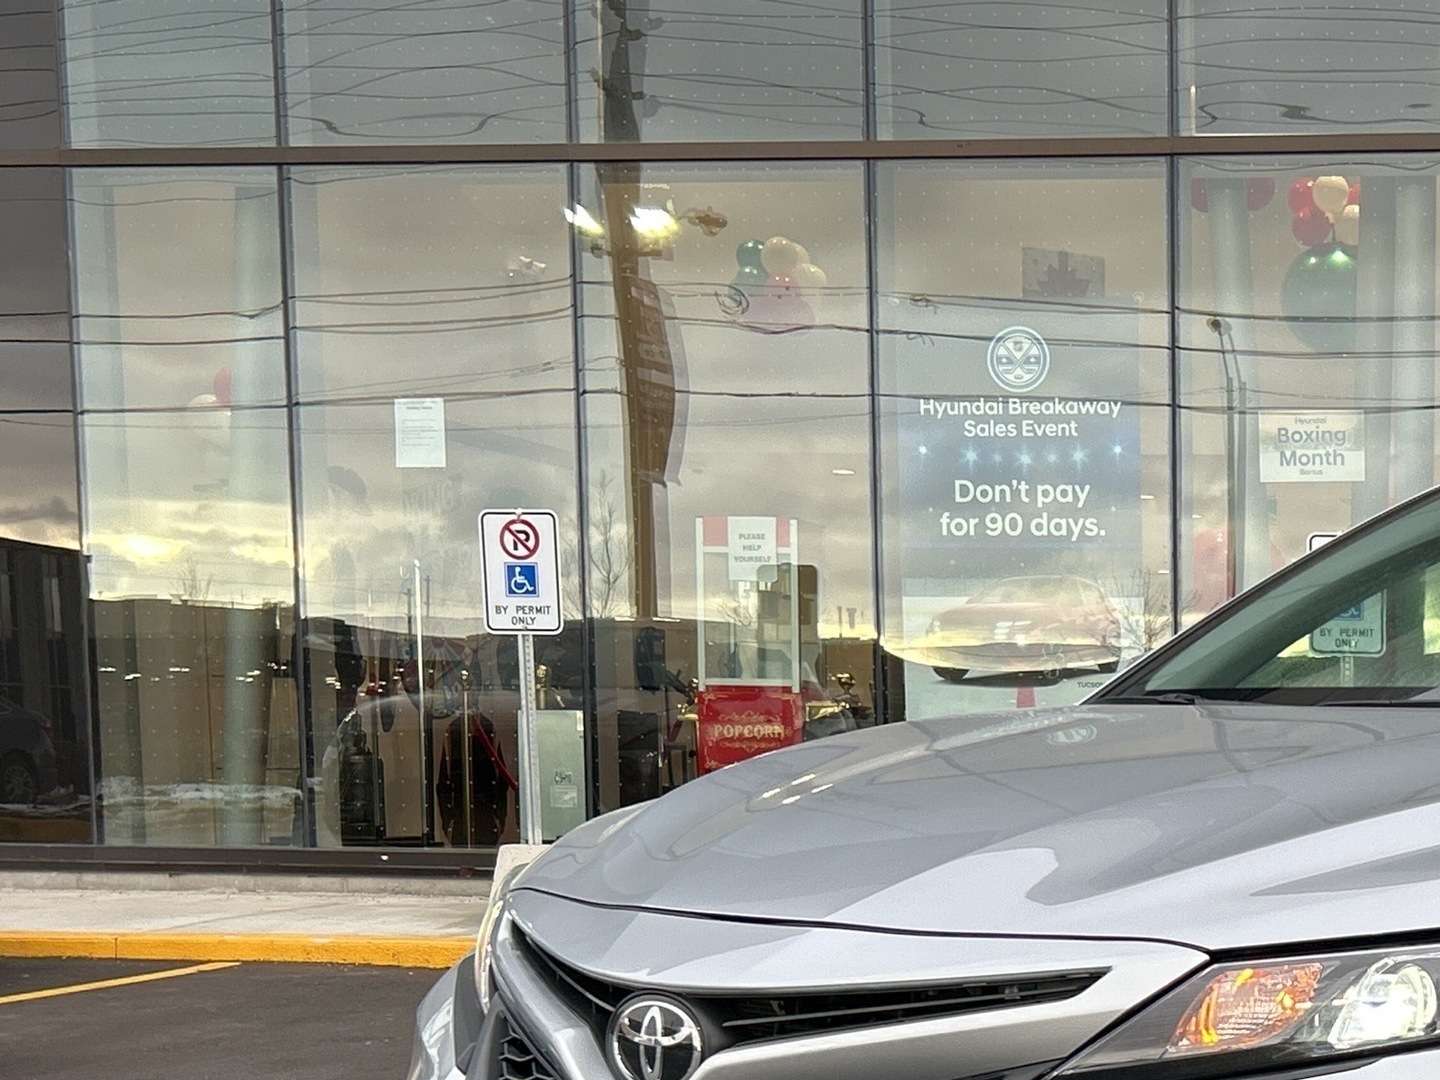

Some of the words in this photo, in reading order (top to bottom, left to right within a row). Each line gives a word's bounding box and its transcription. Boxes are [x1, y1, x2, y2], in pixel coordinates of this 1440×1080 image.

[919, 398, 1003, 419] Hyundai
[1008, 398, 1122, 418] Breakaway
[963, 420, 1017, 437] Sales
[1021, 420, 1078, 437] Event
[1277, 425, 1346, 447] Boxing
[1279, 449, 1345, 466] Month
[1036, 484, 1091, 508] pay
[940, 512, 979, 536] for
[984, 513, 1023, 536] 90
[1030, 512, 1106, 541] days.
[734, 555, 772, 563] YOURSELF
[495, 605, 508, 615] BY
[515, 605, 551, 615] PERMIT
[511, 616, 536, 626] ONLY
[1319, 627, 1332, 637] BY
[1339, 627, 1375, 637] PERMIT
[1334, 638, 1359, 648] ONLY
[714, 723, 785, 739] POPCORN
